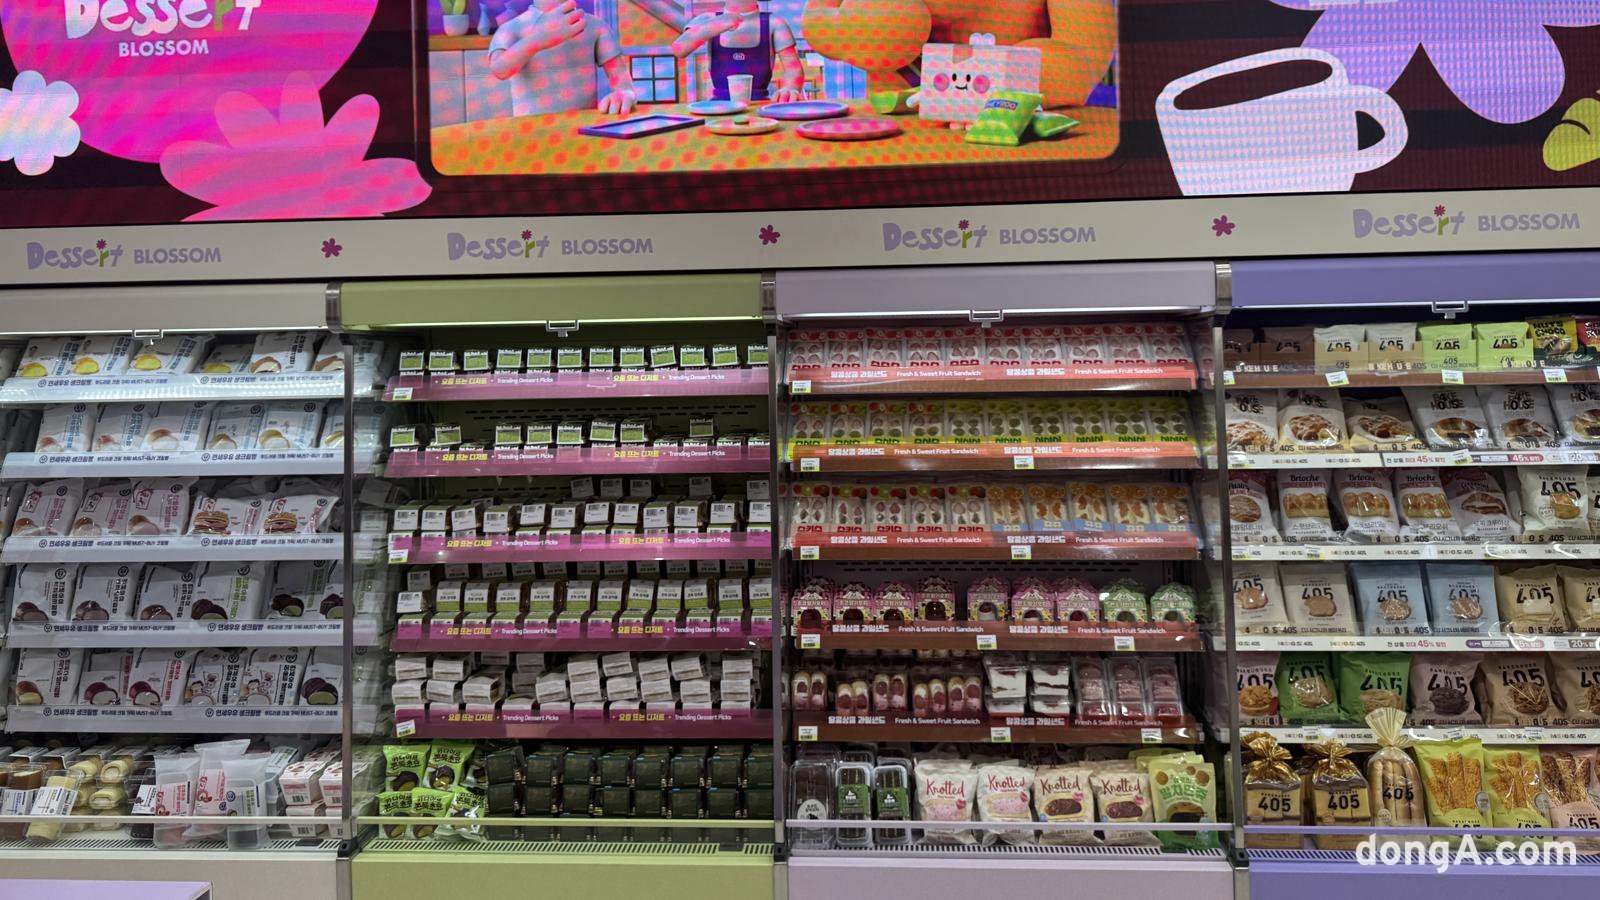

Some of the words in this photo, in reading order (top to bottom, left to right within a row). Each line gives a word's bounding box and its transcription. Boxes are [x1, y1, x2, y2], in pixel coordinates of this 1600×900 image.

[64, 0, 262, 39] Dessert
[118, 39, 209, 57] BLOSSOM
[1352, 204, 1466, 238] Dessert
[1478, 213, 1580, 232] BLOSSOM
[882, 219, 988, 251] Dessert
[1000, 226, 1097, 245] BLOSSOM
[447, 229, 550, 261] Dessert
[561, 238, 654, 256] BLOSSOM
[26, 239, 124, 270] Dessert
[133, 247, 222, 265] BLOSSOM
[1326, 342, 1352, 352] 405
[1379, 340, 1404, 351] 405
[1436, 340, 1460, 350] 405
[1493, 338, 1518, 349] 405
[1430, 400, 1465, 410] HOUSE
[1504, 400, 1535, 410] HOUSE
[1540, 481, 1582, 500] 405
[1232, 578, 1264, 594] 405
[1302, 588, 1334, 601] 405
[1378, 590, 1409, 603] 405
[1448, 588, 1480, 603] 405
[1516, 586, 1554, 604] 405
[1238, 674, 1274, 691] 405
[1288, 665, 1325, 684] 405
[1502, 668, 1544, 687] 405
[1360, 674, 1402, 696] 405
[1428, 673, 1468, 696] 405
[926, 779, 965, 798] Knotted
[988, 774, 1026, 790] Knotted
[1041, 775, 1081, 796] Knotted
[1102, 778, 1142, 794] Knotted
[1382, 787, 1414, 800] 405
[1258, 796, 1292, 812] 405
[1328, 794, 1360, 810] 405
